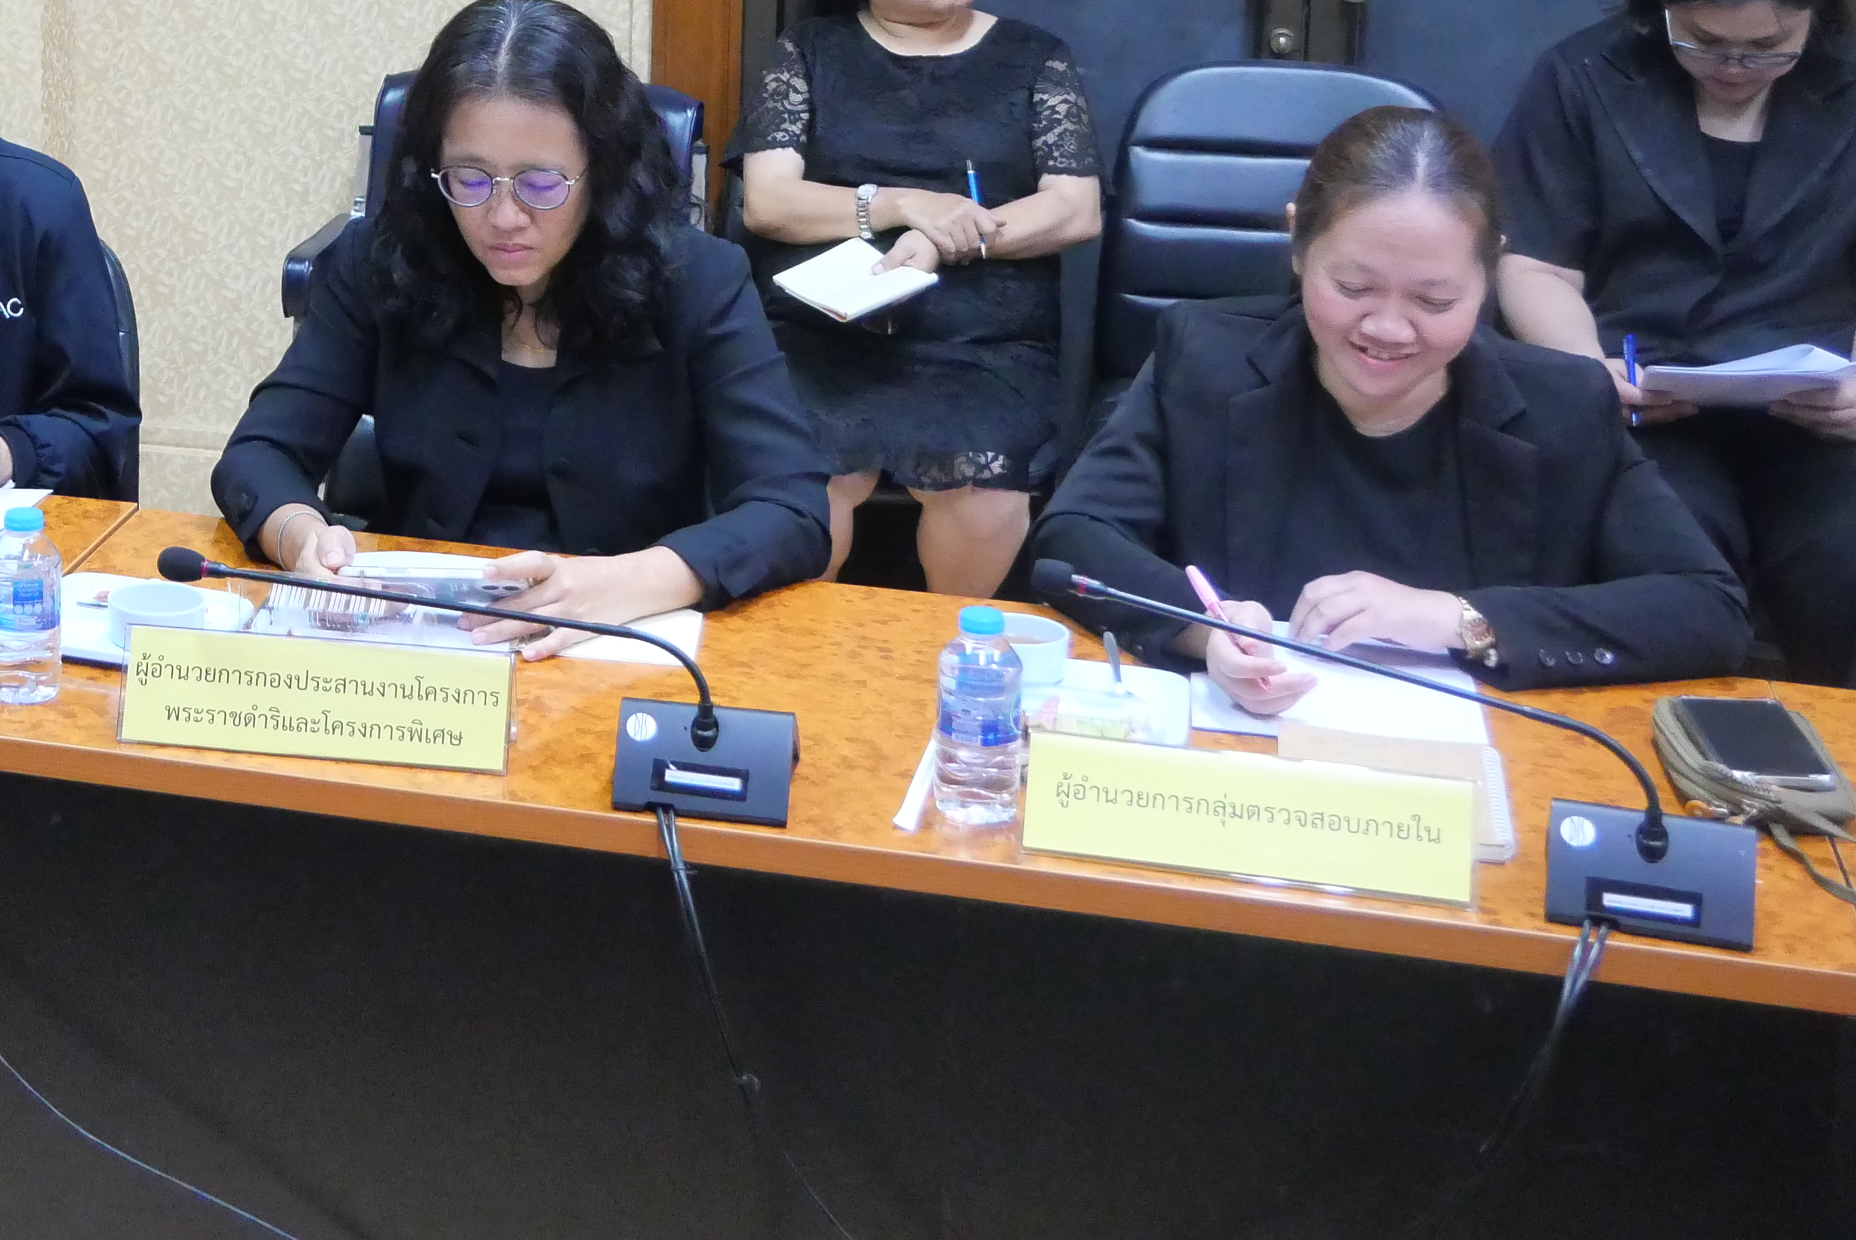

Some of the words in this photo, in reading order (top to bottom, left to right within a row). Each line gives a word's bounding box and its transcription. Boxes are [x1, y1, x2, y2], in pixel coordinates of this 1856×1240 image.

[135, 653, 501, 707] ผู้อำนวยการกองประสานงานโครงการ
[164, 703, 464, 747] พระราชดำริและโครงการพิเศษ
[1055, 771, 1442, 844] ผู้อำนวยการกลุ่มตรวจสอบภายใน
